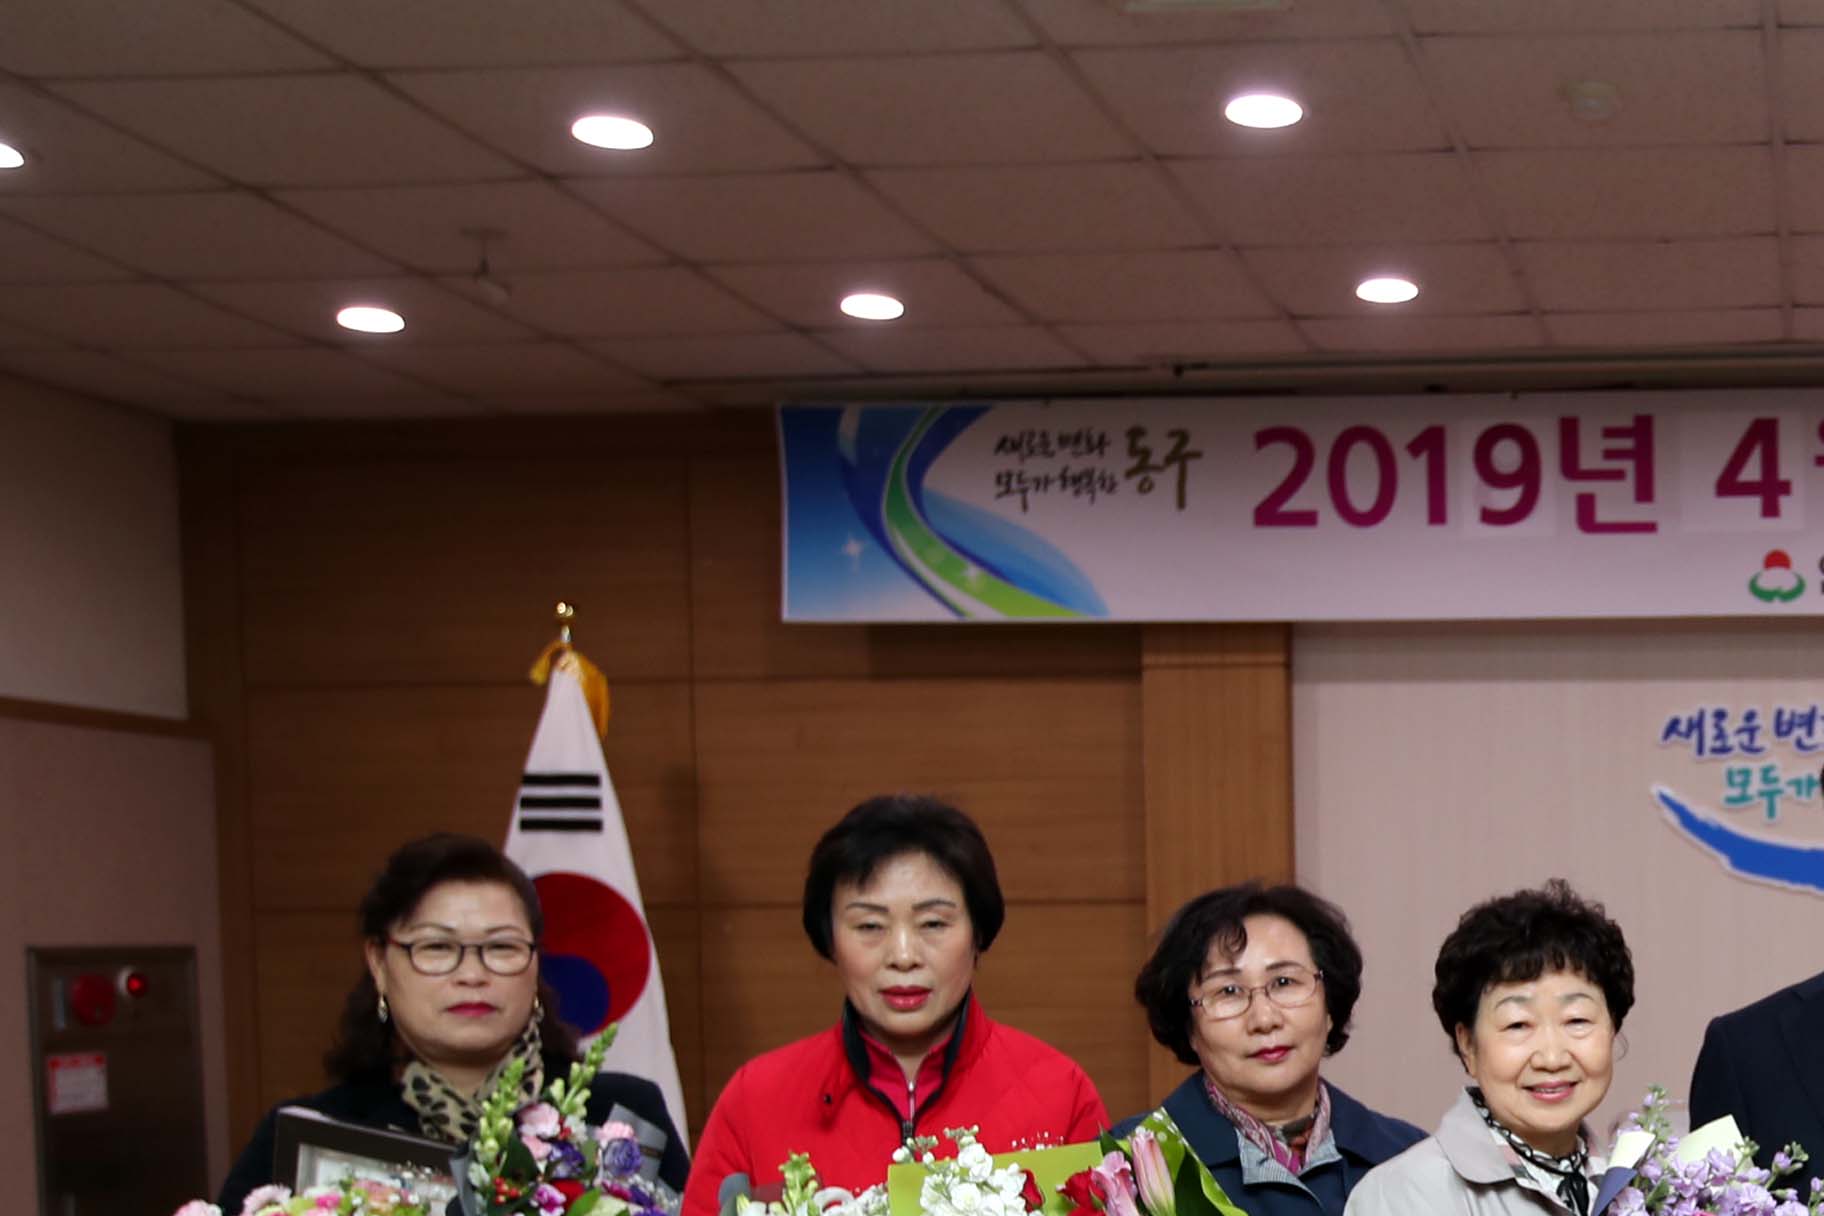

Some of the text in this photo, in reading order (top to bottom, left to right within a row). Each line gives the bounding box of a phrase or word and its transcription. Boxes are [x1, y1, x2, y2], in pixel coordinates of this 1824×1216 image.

[994, 429, 1111, 461] 새로운 변화
[1124, 425, 1203, 510] 동구
[995, 470, 1053, 512] 모두가
[1253, 413, 1658, 534] 2019년
[1662, 708, 1765, 757] 새로운
[1724, 763, 1822, 819] 모두가
